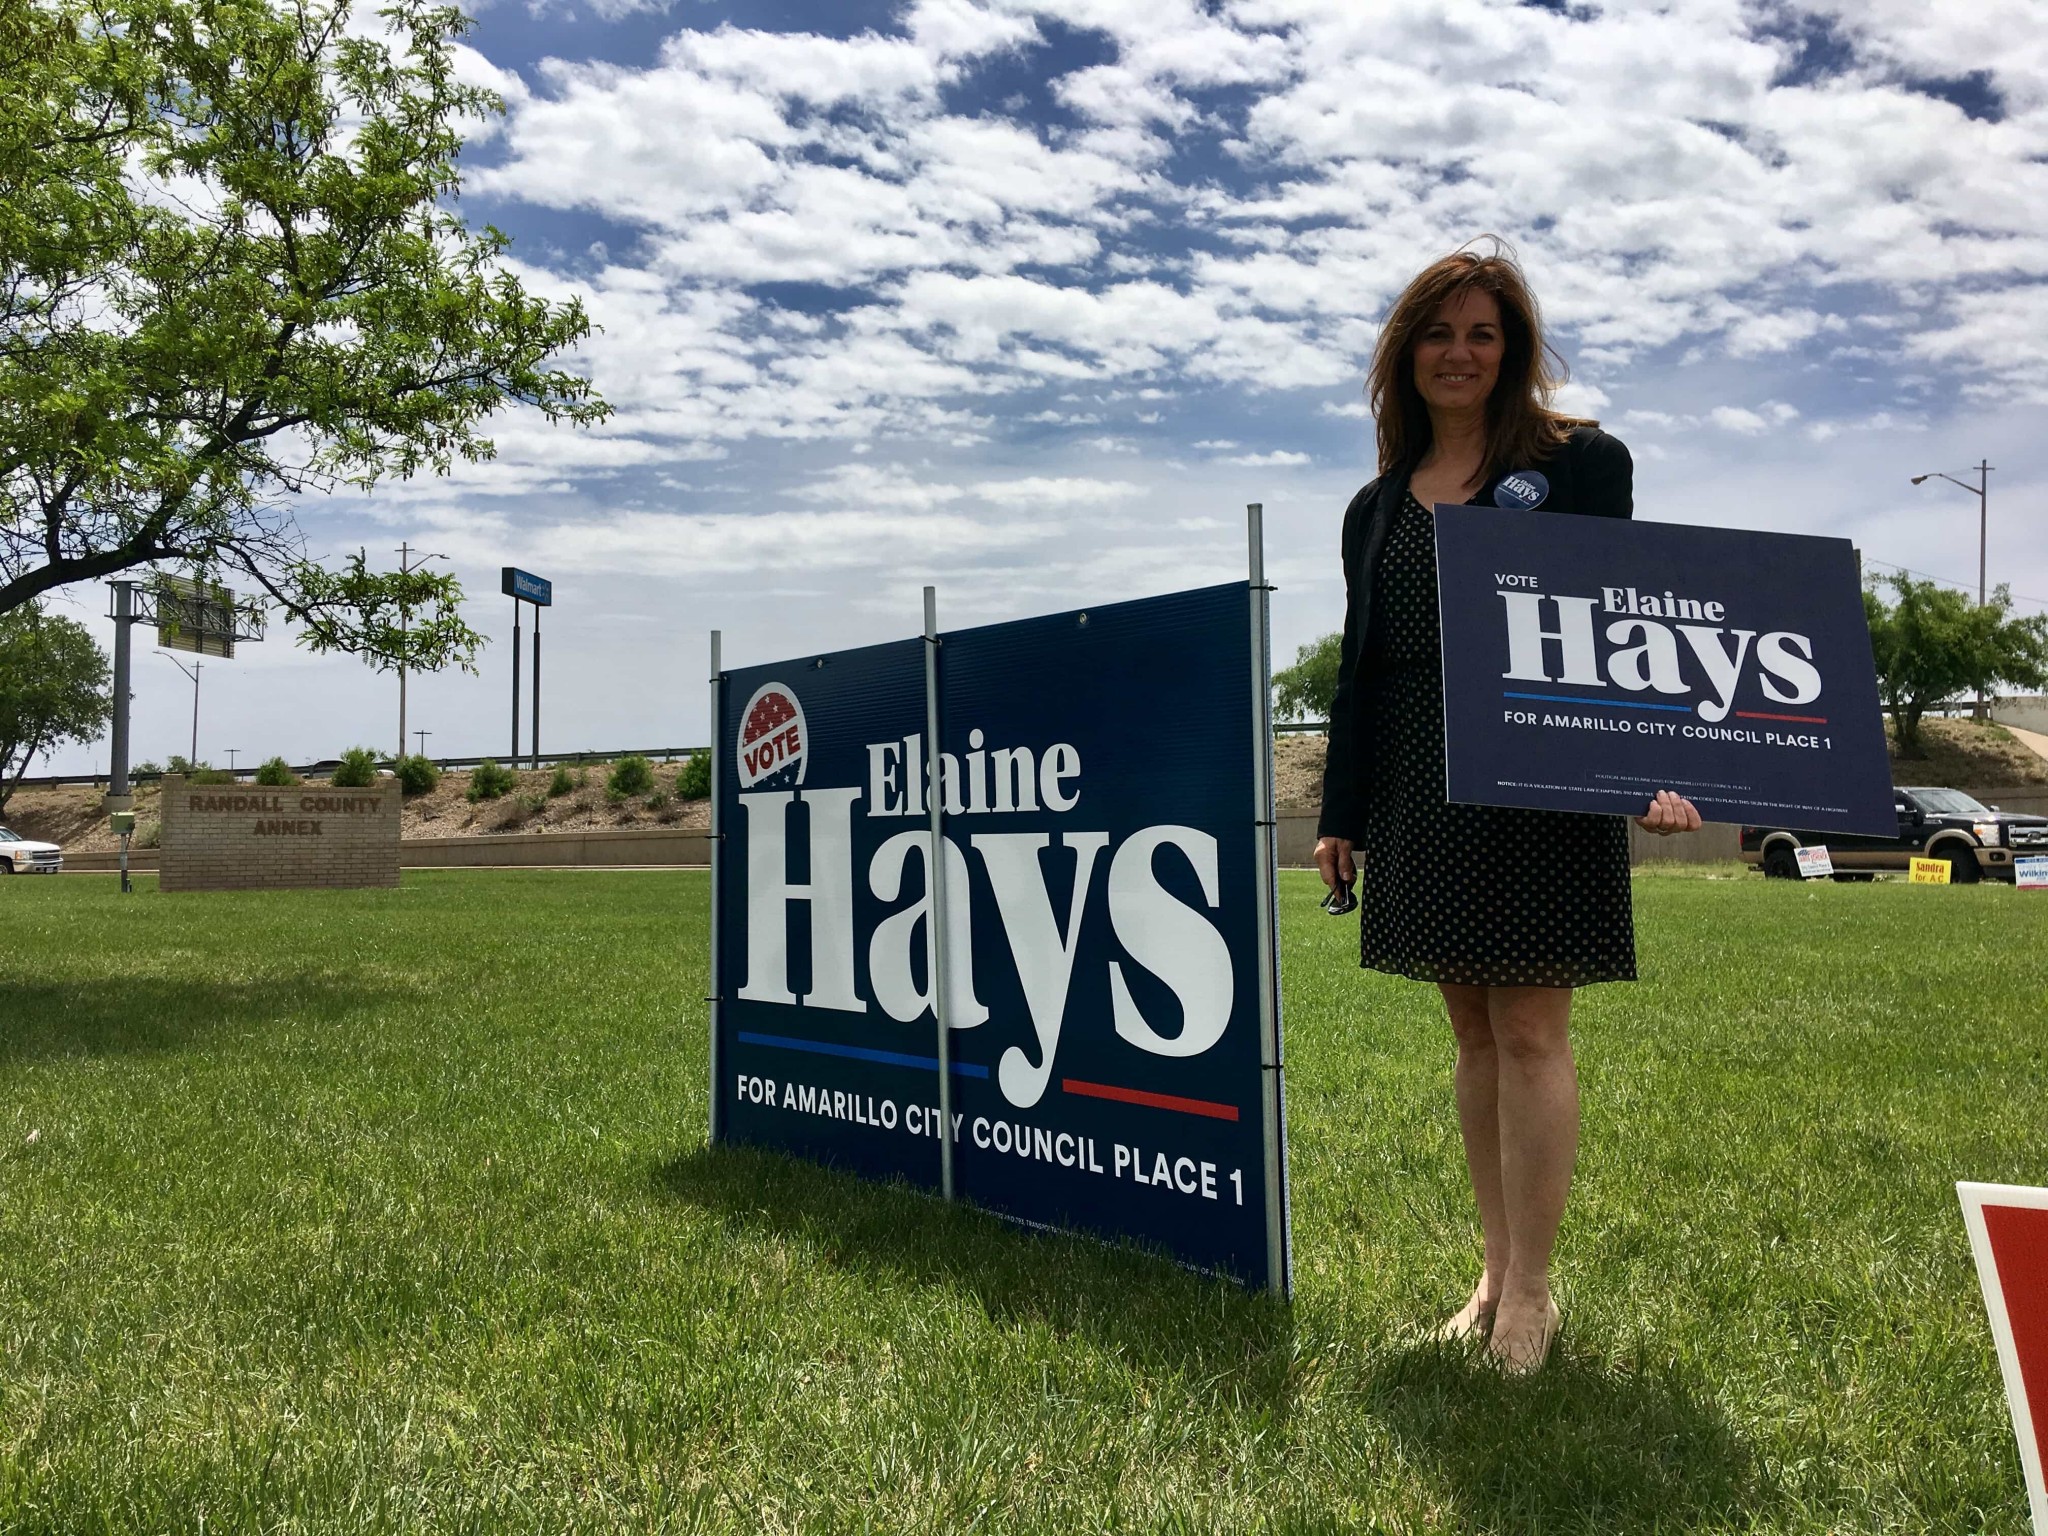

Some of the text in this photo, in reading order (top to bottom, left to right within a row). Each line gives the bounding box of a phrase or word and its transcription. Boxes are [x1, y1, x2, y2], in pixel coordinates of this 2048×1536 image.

[1502, 475, 1540, 501] Hays
[516, 575, 542, 597] Walmart
[1495, 573, 1538, 588] VOTE
[1601, 586, 1726, 622] Elaine
[1497, 590, 1822, 722] Hays
[1504, 711, 1832, 750] FOR AMARILLO CITY COUNCIL PLACE 1
[743, 725, 801, 778] VOTE
[866, 728, 1081, 818] Elaine
[189, 795, 381, 813] RANDALL COUNTY
[254, 820, 322, 836] ANNEX
[1916, 862, 1944, 874] Sandra
[1916, 873, 1926, 882] for
[738, 786, 1234, 1108] Hays
[738, 1074, 1243, 1206] FOR AMARILLO CITY COUNCIL PLACE 1
